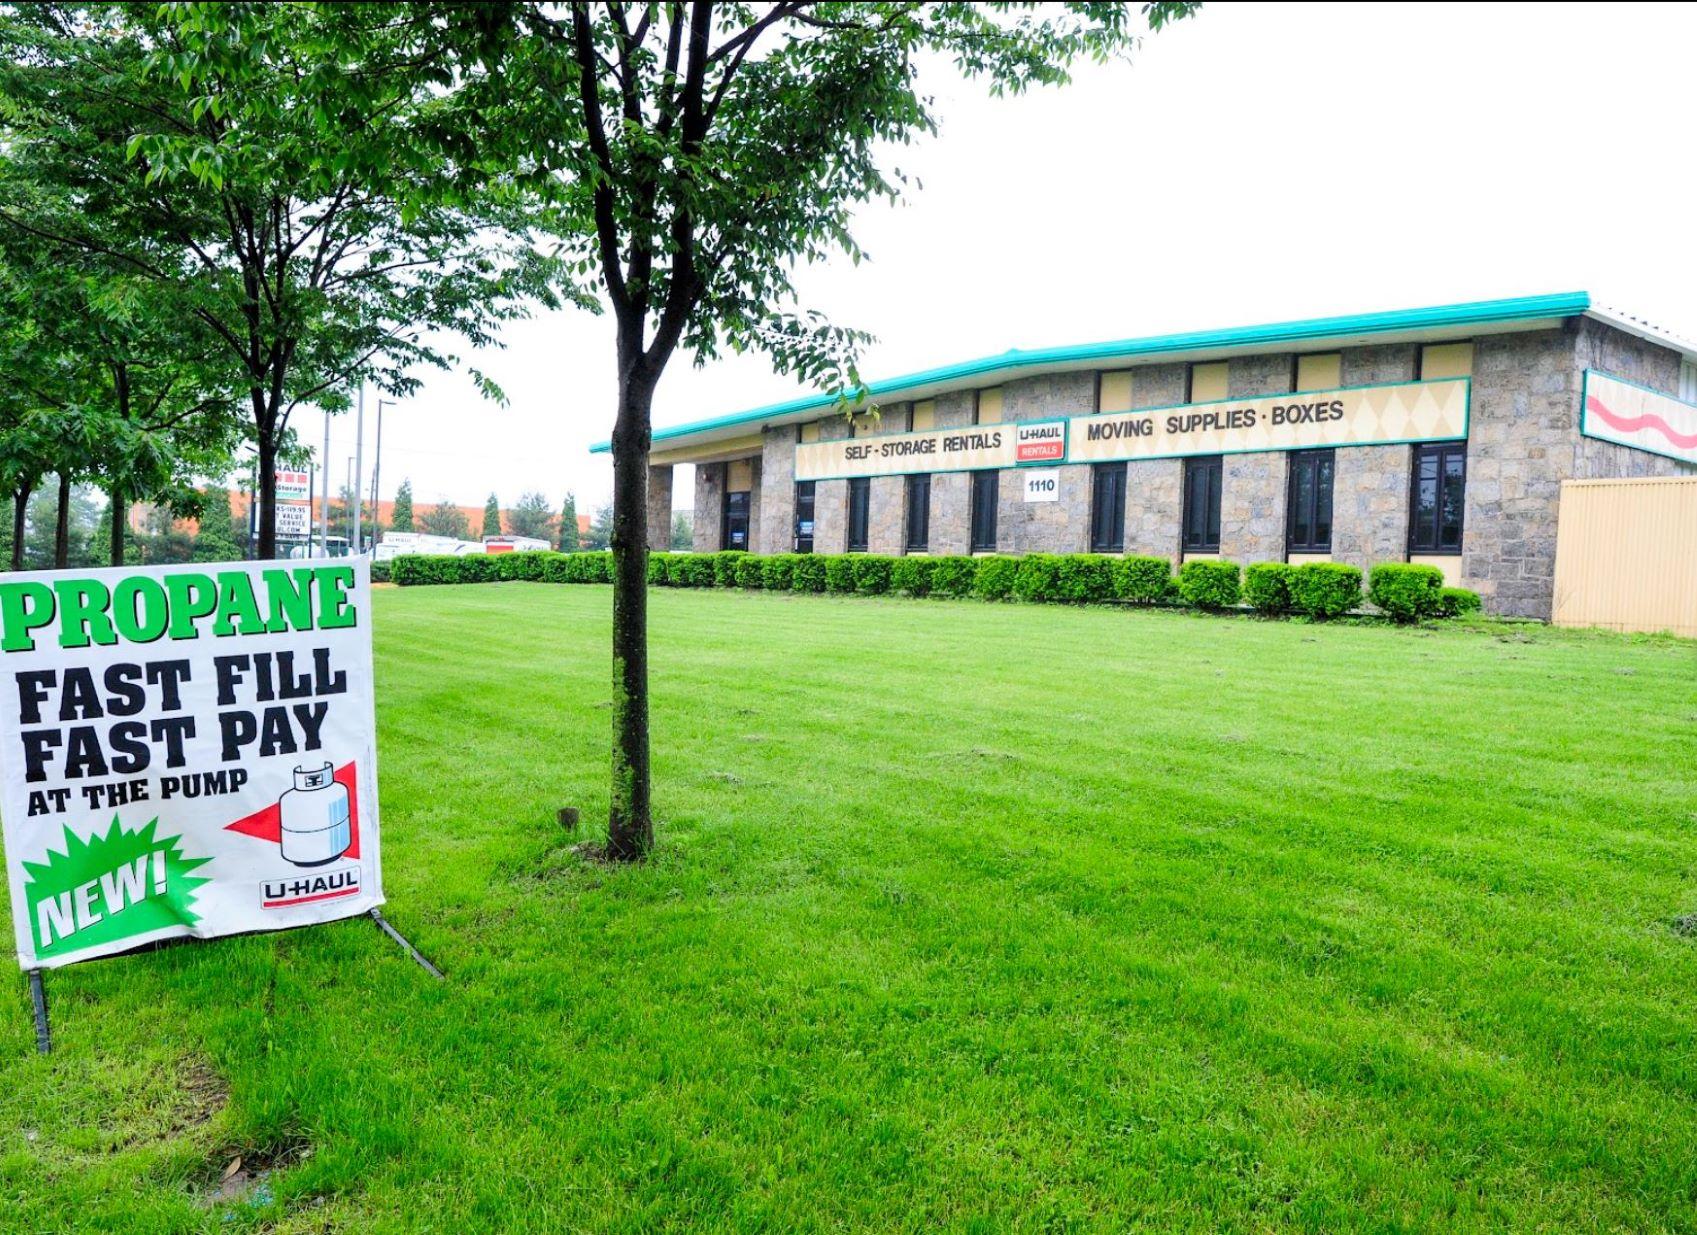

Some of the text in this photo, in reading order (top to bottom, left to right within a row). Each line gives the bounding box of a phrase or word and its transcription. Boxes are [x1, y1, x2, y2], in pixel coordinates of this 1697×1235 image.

[1020, 427, 1061, 440] U-HAUL
[1088, 418, 1153, 441] MOVING
[1166, 409, 1256, 434] SUPPLIES
[1271, 400, 1344, 425] BOXES
[943, 432, 1001, 452] RENTALS
[1021, 445, 1058, 457] RENTALS
[1028, 478, 1055, 493] 1110
[0, 566, 357, 652] PROPANE
[15, 647, 348, 724] FAST FILL
[20, 701, 329, 783] FAST PAY
[27, 767, 249, 817] AT THE PUMP
[36, 849, 168, 948] NEW!
[264, 871, 358, 899] U-HAUL
